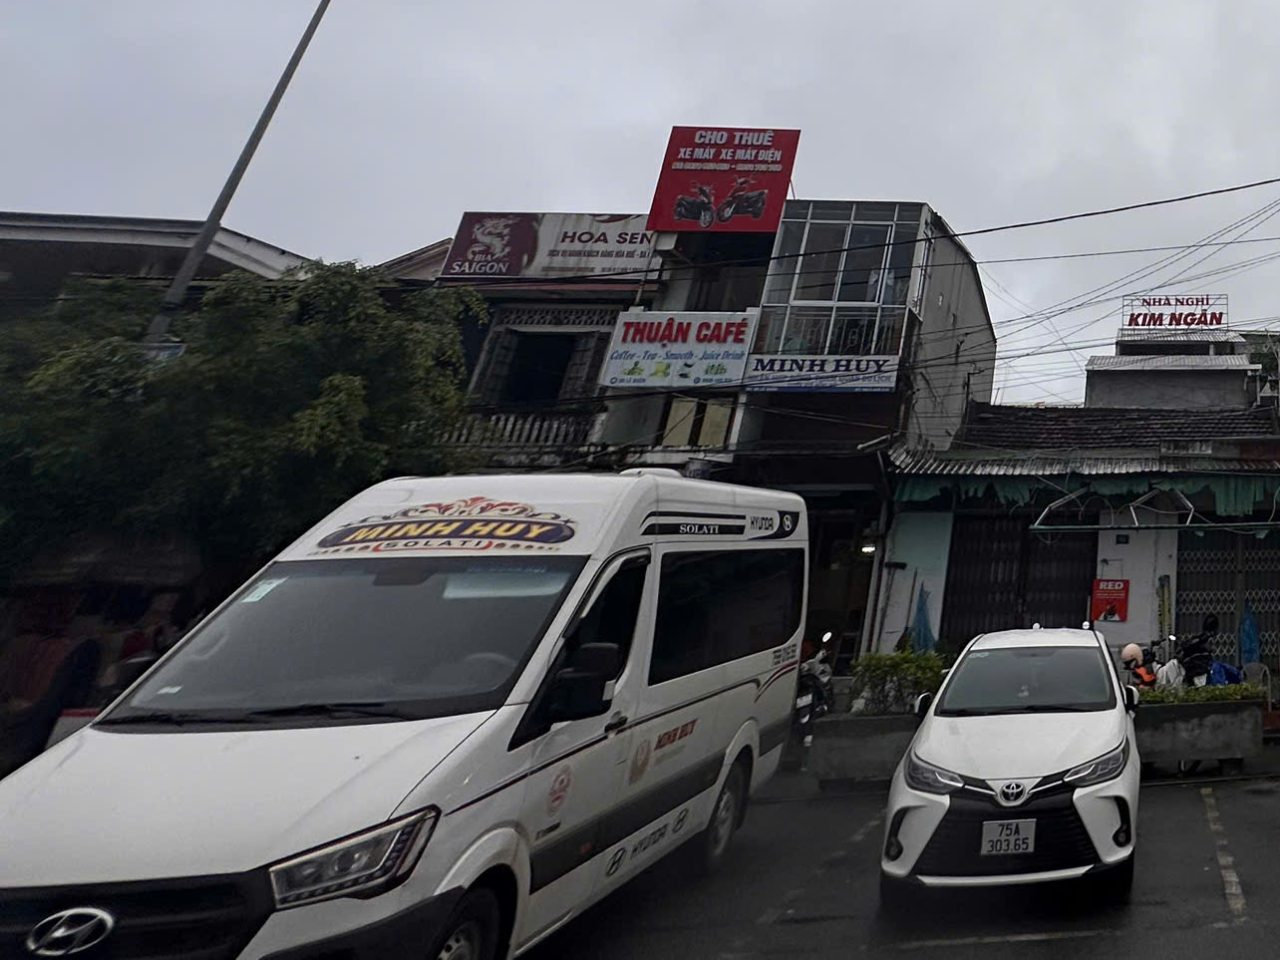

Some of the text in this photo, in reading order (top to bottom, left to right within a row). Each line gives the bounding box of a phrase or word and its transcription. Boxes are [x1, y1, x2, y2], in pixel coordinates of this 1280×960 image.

[695, 129, 774, 145] CHO THUÊ
[678, 148, 692, 159] XE
[693, 146, 716, 160] MÁY
[719, 148, 734, 160] XE
[560, 231, 654, 245] HOA SEN
[450, 262, 509, 273] SAIGON
[1128, 312, 1164, 326] KIM
[621, 316, 748, 348] THUẬN CAFÉ
[610, 350, 636, 360] Coffee
[753, 358, 890, 373] MINH HUY
[344, 521, 555, 541] MINH HUY
[680, 524, 719, 534] SOLATI
[383, 539, 482, 550] SOLATI
[1099, 581, 1124, 590] RED
[998, 823, 1020, 837] 75A
[986, 837, 1030, 853] 303.65
